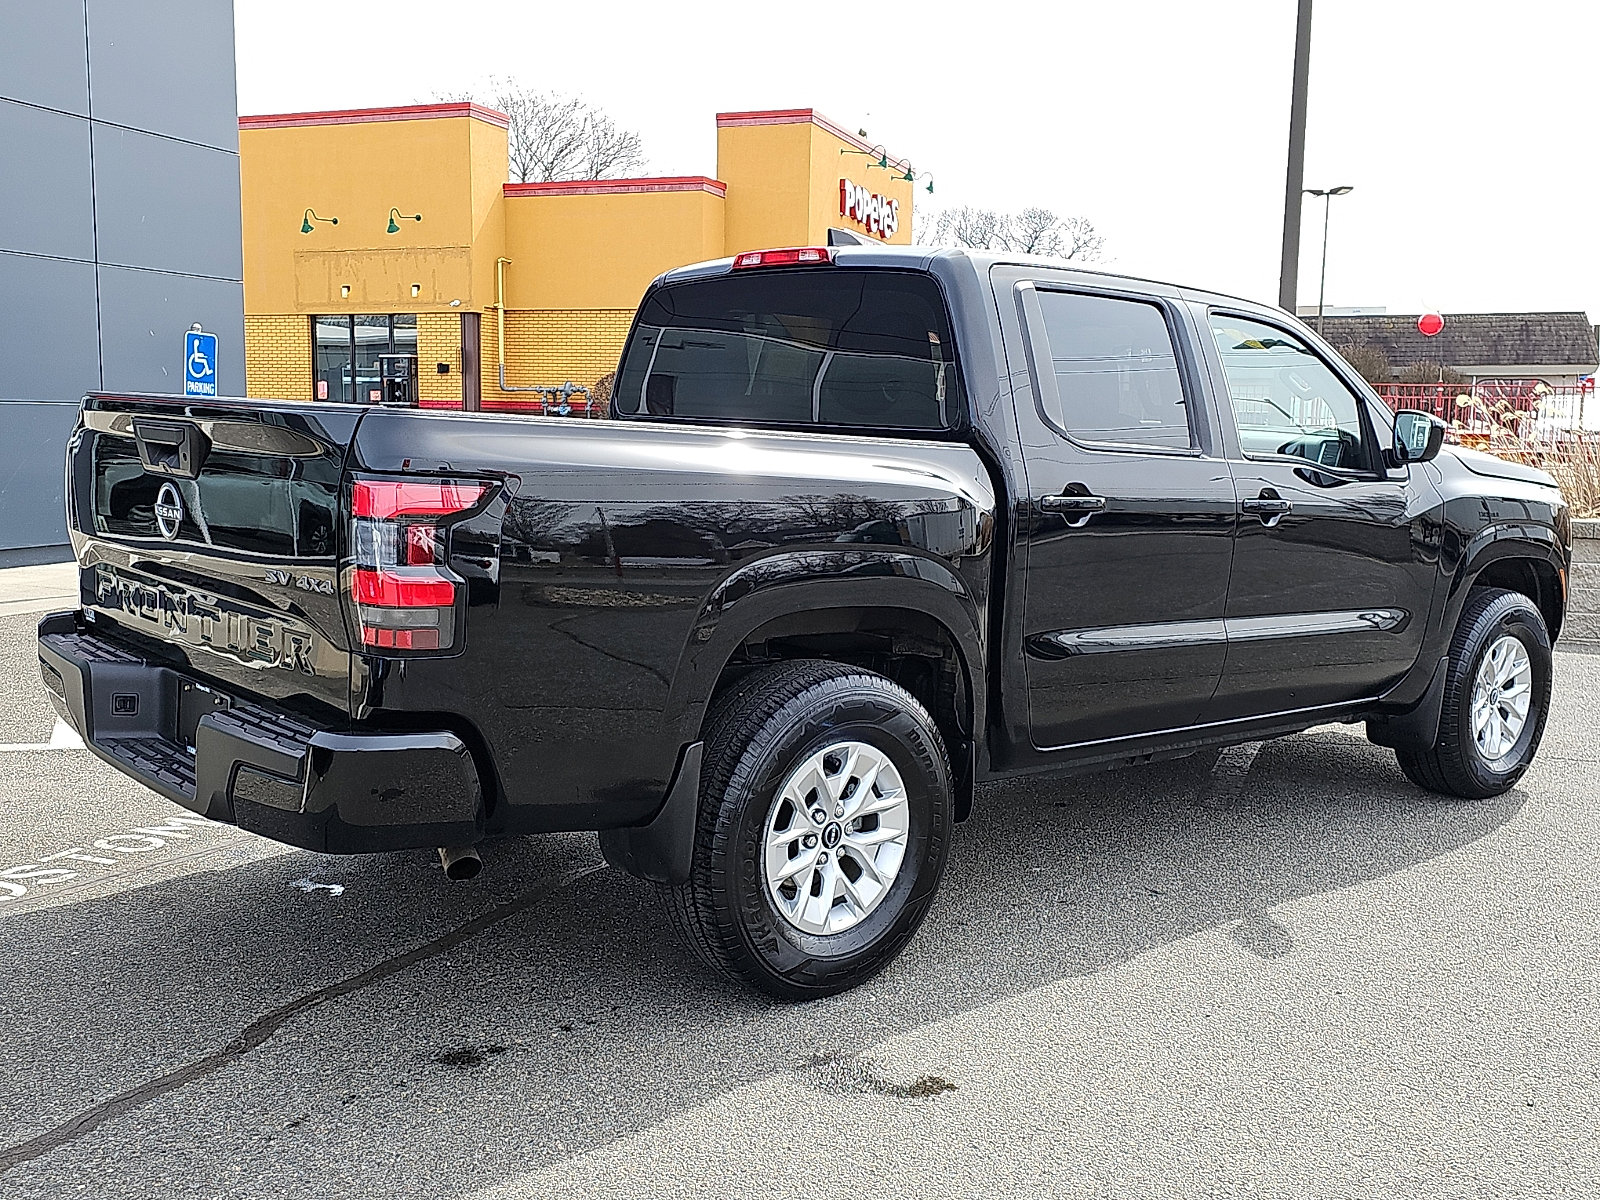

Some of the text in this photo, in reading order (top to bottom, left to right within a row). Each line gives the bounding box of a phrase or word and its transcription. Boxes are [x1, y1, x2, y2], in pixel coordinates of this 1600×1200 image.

[187, 381, 215, 395] PARKING
[264, 568, 292, 586] SV
[96, 569, 315, 677] FRONTIER
[0, 812, 213, 901] STOM
